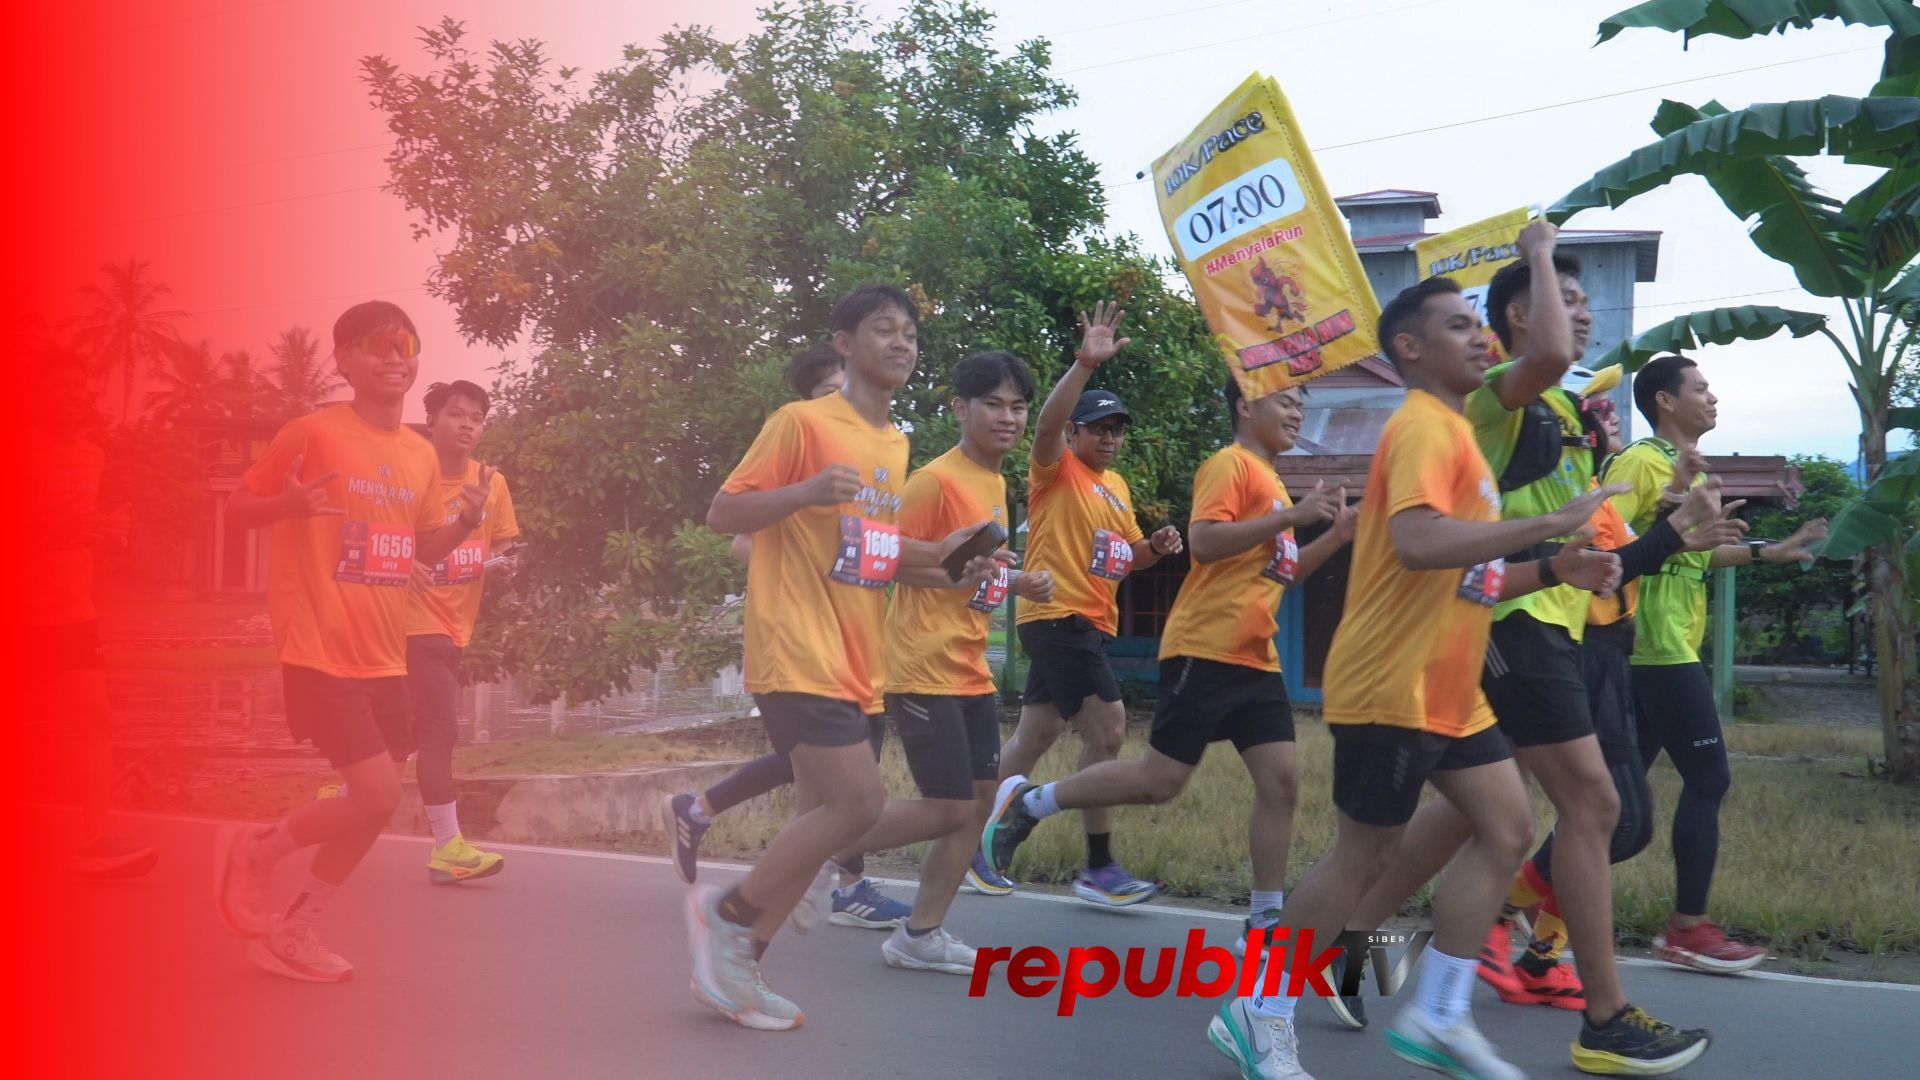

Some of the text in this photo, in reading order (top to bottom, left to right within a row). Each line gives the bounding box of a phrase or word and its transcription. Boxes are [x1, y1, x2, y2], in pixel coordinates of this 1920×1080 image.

[1165, 110, 1265, 197] 10K/Pace
[1189, 174, 1286, 244] 07:00
[1205, 225, 1304, 277] #MenyalaRun
[371, 532, 413, 560] 1656
[452, 546, 483, 567] 1614
[863, 528, 900, 561] 1606
[1692, 737, 1718, 747] 2XU
